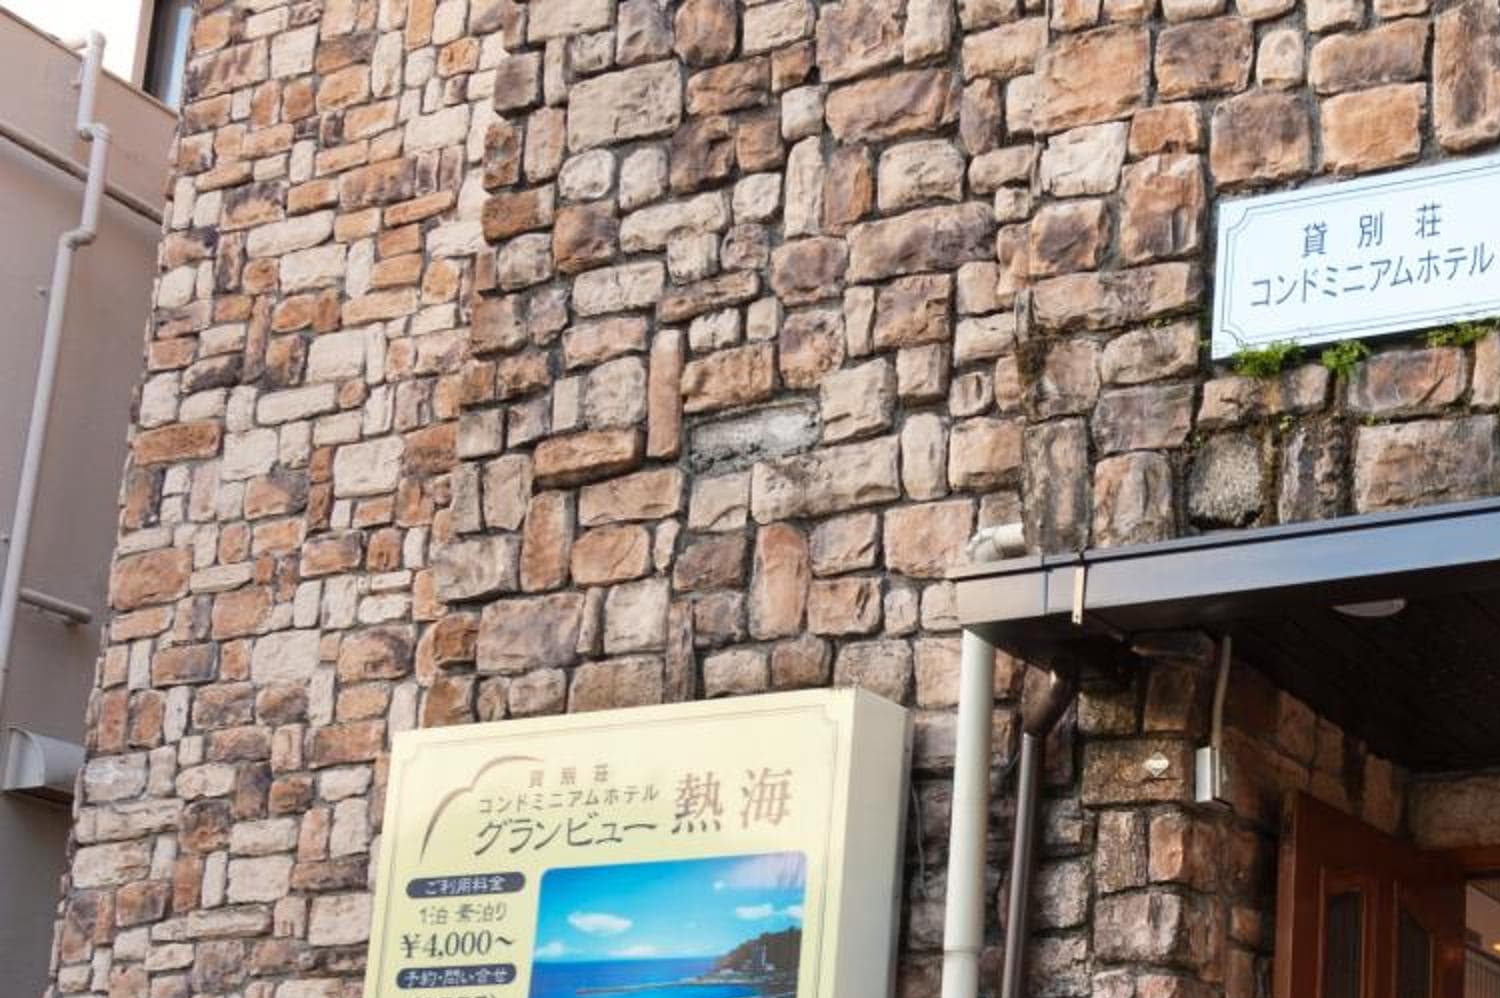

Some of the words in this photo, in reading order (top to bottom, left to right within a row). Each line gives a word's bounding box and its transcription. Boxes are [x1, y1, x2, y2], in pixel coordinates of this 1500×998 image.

[1301, 203, 1442, 257] 貸別荘
[1250, 242, 1495, 306] コンドミニアムホテル
[474, 812, 656, 856] グランビュー
[671, 767, 794, 834] 熱海
[479, 784, 660, 814] コンドミニアムホテル
